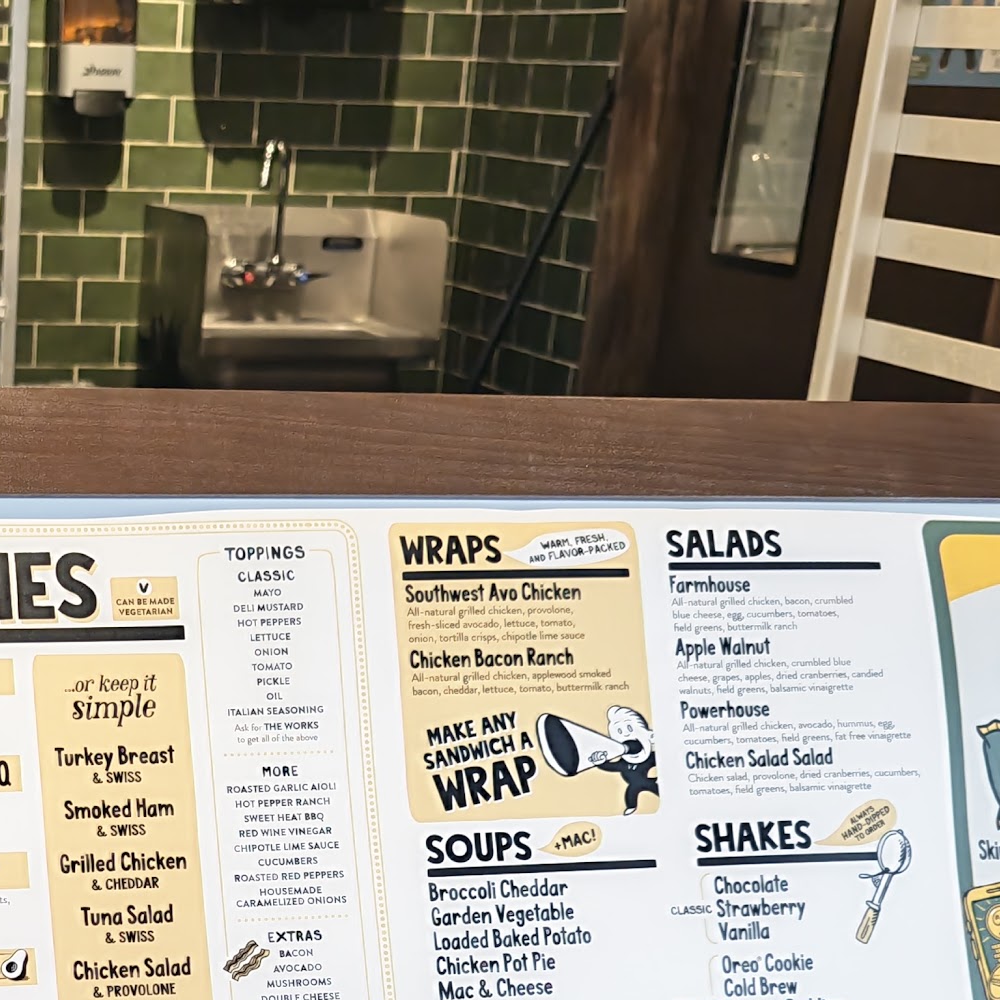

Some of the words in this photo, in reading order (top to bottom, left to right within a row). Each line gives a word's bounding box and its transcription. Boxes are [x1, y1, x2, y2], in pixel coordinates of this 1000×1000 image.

[399, 535, 501, 565] WRAPS
[530, 554, 545, 563] AND
[548, 540, 625, 560] FLAVOR-PACKED
[540, 539, 572, 549] WARM,
[575, 533, 608, 545] FRESH,
[666, 530, 782, 558] SALADS
[224, 546, 305, 560] TOPPINGS
[238, 570, 294, 582] CLASSIC
[669, 575, 750, 593] Farmhouse
[254, 589, 281, 597] MAYO
[405, 584, 484, 603] Southwest
[489, 583, 517, 601] Avo
[522, 582, 581, 600] Chicken
[671, 597, 717, 606] All-natural
[720, 597, 745, 609] grilled
[748, 597, 783, 606] chicken,
[785, 596, 812, 606] bacon,
[815, 595, 853, 604] crumbled
[238, 619, 257, 627] HOT
[261, 618, 301, 626] PEPPERS
[410, 650, 470, 668] Chicken
[474, 648, 523, 667] Bacon
[527, 648, 573, 666] Ranch
[676, 638, 715, 662] Apple
[719, 637, 770, 655] Walnut
[99, 675, 141, 697] keep
[144, 675, 156, 691] it
[73, 691, 156, 727] simple
[680, 701, 769, 719] Powerhouse
[427, 720, 476, 748] MAKE
[482, 711, 515, 735] ANY
[55, 747, 113, 771] Turkey
[118, 745, 174, 765] Breast
[424, 734, 515, 771] SANDWICH
[521, 732, 533, 750] A
[686, 751, 744, 769] Chicken
[748, 748, 788, 767] Salad
[793, 747, 833, 765] Salad
[263, 766, 298, 776] MORE
[431, 753, 536, 811] WRAP
[64, 799, 131, 819] Smoked
[136, 798, 174, 817] Ham
[850, 806, 876, 826] ALWAYS
[841, 806, 891, 842] HAND-DIPPED
[695, 820, 811, 852] SHAKES
[426, 831, 531, 864] SOUPS
[60, 853, 115, 873] Grilled
[121, 851, 186, 871] Chicken
[258, 857, 318, 866] CUCUMBERS
[92, 879, 102, 890] &
[106, 877, 159, 890] CHEDDAR
[429, 881, 496, 901] Broccoli
[500, 878, 568, 898] Cheddar
[714, 875, 788, 894] Chocolate
[81, 907, 122, 926] Tuna
[127, 904, 173, 924] Salad
[432, 906, 491, 926] Garden
[495, 902, 574, 927] Vegetable
[671, 905, 712, 915] CLASSIC
[716, 898, 805, 920] Strawberry
[268, 930, 322, 942] EXTRAS
[434, 930, 488, 950] Loaded
[492, 927, 539, 948] Baked
[543, 926, 591, 945] Potato
[718, 921, 770, 940] Vanilla
[279, 949, 313, 957] BACON
[437, 955, 499, 975] Chicken
[503, 953, 528, 972] Pot
[532, 952, 555, 970] Pie
[765, 953, 813, 972] Cookie
[74, 960, 140, 980] Chicken
[144, 956, 191, 977] Salad
[439, 981, 473, 1000] Mac
[479, 980, 493, 998] &
[497, 978, 553, 997] Cheese
[724, 977, 756, 997] Cold
[760, 977, 797, 995] Brew
